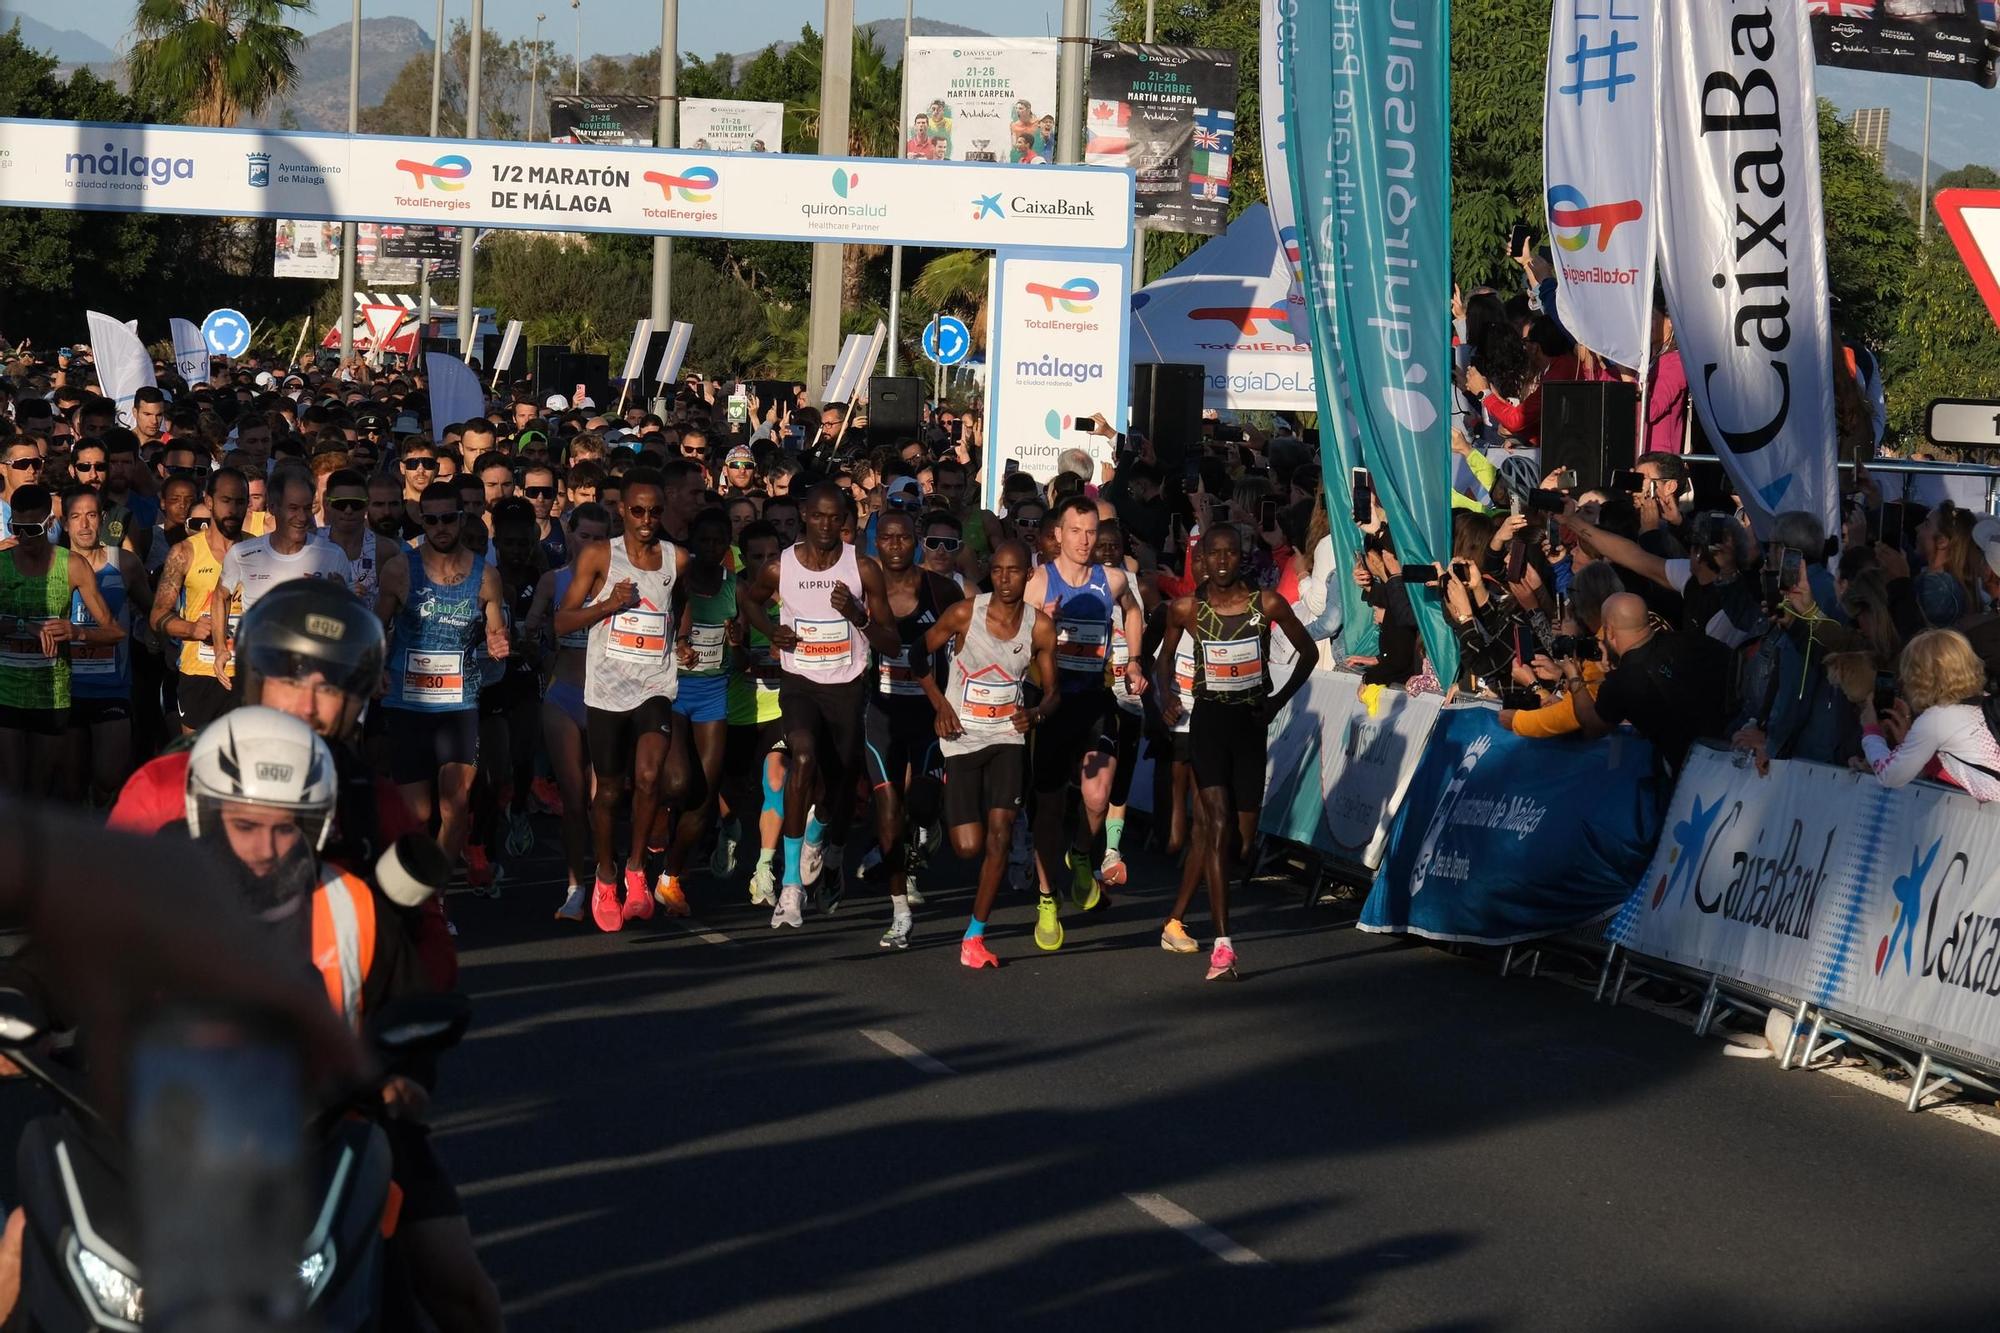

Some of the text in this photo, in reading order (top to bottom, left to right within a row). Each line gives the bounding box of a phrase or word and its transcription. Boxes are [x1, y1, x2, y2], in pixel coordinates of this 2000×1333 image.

[966, 67, 995, 77] 21-26
[1148, 71, 1177, 82] 21-26
[951, 79, 1010, 88] NOVIEMBRE
[1132, 81, 1192, 94] NOVIEMBRE
[947, 89, 1015, 98] MARTÍN CARPENA
[1127, 92, 1198, 104] MARTÍN CARPENA
[579, 122, 621, 130] NOVIEMBRE
[710, 124, 752, 132] NOVIEMBRE
[66, 143, 193, 186] málaga
[278, 163, 342, 175] Ayuntamiento
[278, 172, 325, 185] de Málaga
[492, 164, 630, 188] 1/2 MARATÓN
[76, 178, 108, 189] ciudad
[110, 180, 148, 190] redonda
[394, 196, 471, 211] TotalEnergies
[491, 190, 612, 213] DE MÁLAGA
[1011, 196, 1095, 217] CaixaBank
[642, 208, 718, 221] TotalEnergies
[801, 202, 887, 218] quirónsalud
[808, 220, 880, 232] Healthcare Partner
[1700, 0, 1792, 454] CaixaBa
[1024, 319, 1099, 333] TotalEnergies
[1016, 354, 1103, 383] málaga
[635, 635, 645, 649] 9
[804, 644, 842, 654] Chebon
[1230, 665, 1239, 677] 8
[426, 676, 444, 689] 30
[987, 706, 997, 718] 3
[1694, 800, 1837, 941] CaixaBank
